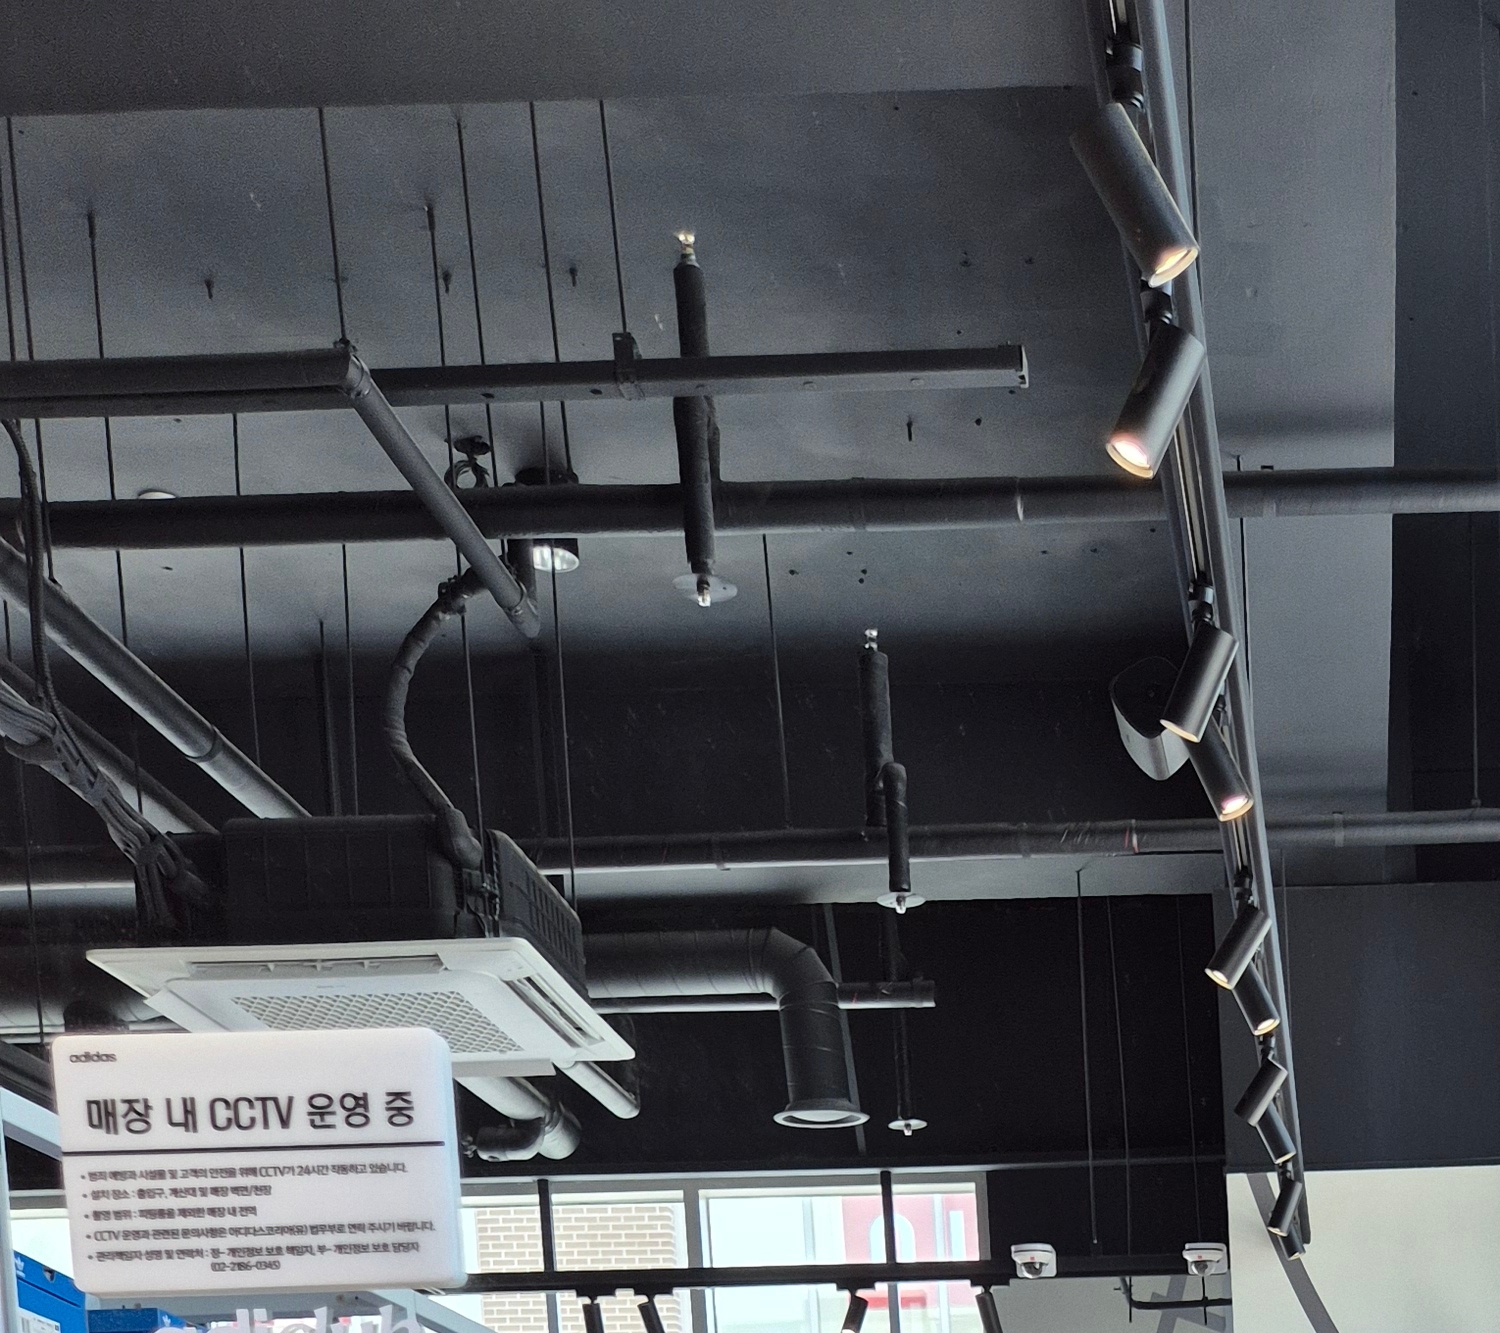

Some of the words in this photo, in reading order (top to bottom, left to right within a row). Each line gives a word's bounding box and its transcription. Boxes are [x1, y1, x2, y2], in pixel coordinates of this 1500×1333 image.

[69, 1051, 117, 1063] adidas
[86, 1097, 152, 1135] 매장
[167, 1095, 198, 1133] 내
[209, 1096, 295, 1132] CCTV
[307, 1091, 370, 1130] 운영
[385, 1090, 414, 1127] 중
[297, 1164, 329, 1176] 24시간
